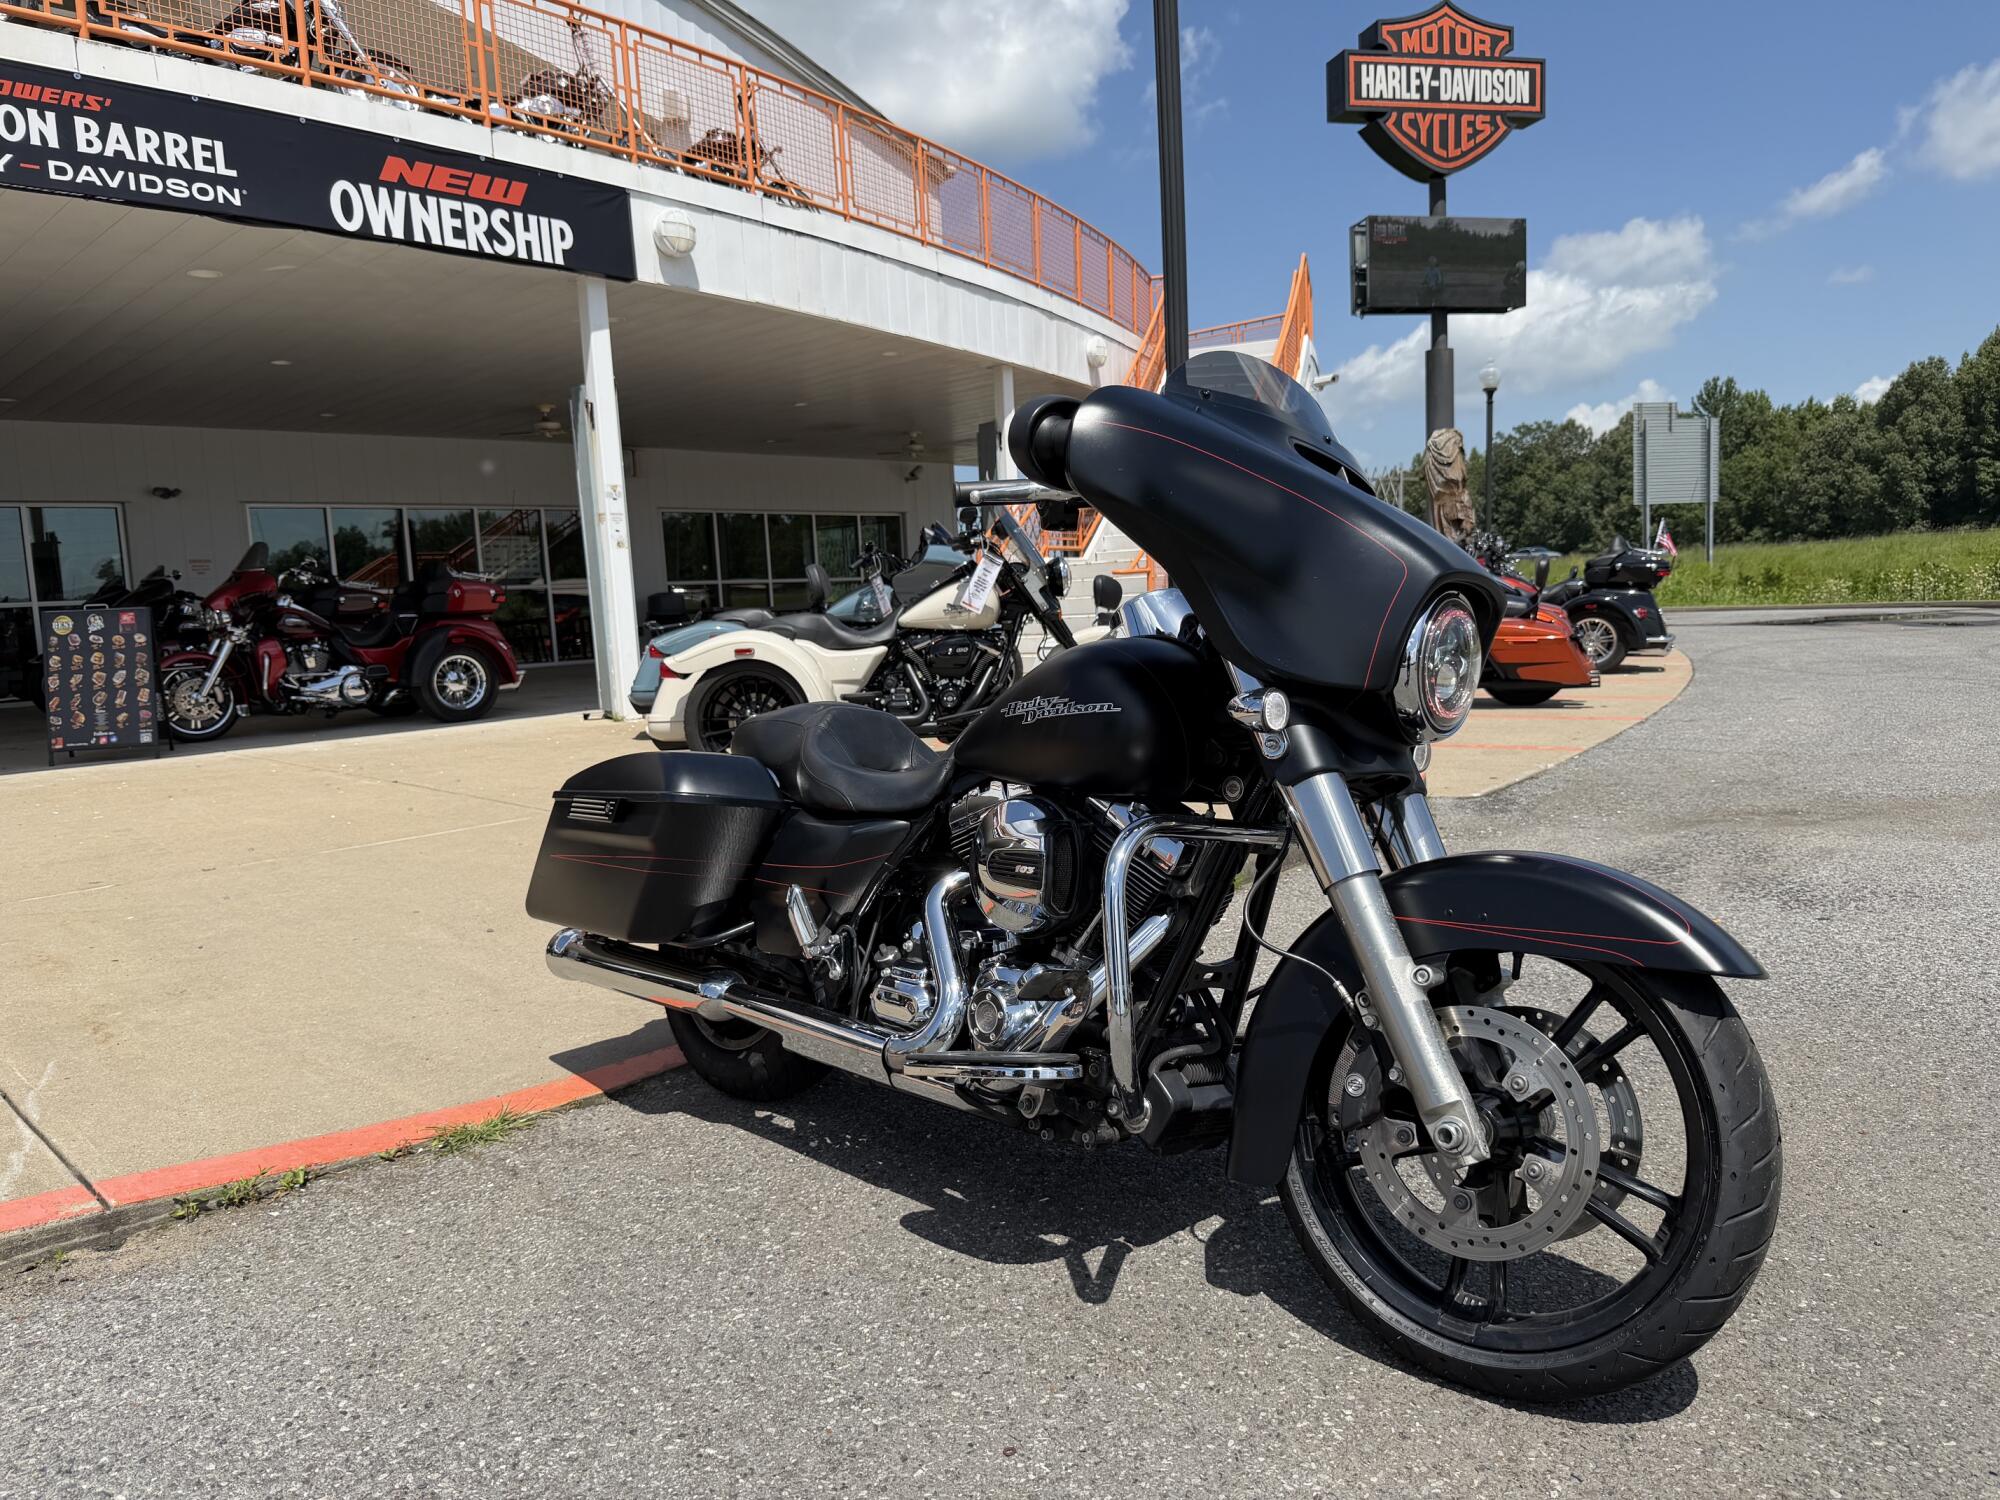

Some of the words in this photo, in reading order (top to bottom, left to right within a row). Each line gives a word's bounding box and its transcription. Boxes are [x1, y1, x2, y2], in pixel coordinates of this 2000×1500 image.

[1401, 17, 1491, 57] MOTOR
[1360, 63, 1530, 104] HARLEY-DAVIDSON
[73, 115, 238, 177] BARREL
[1401, 112, 1491, 158] CYCLES
[47, 159, 242, 207] DAVIDSON
[378, 155, 528, 207] NEW
[329, 179, 574, 265] OWNERSHIP
[1014, 864, 1036, 875] 103
